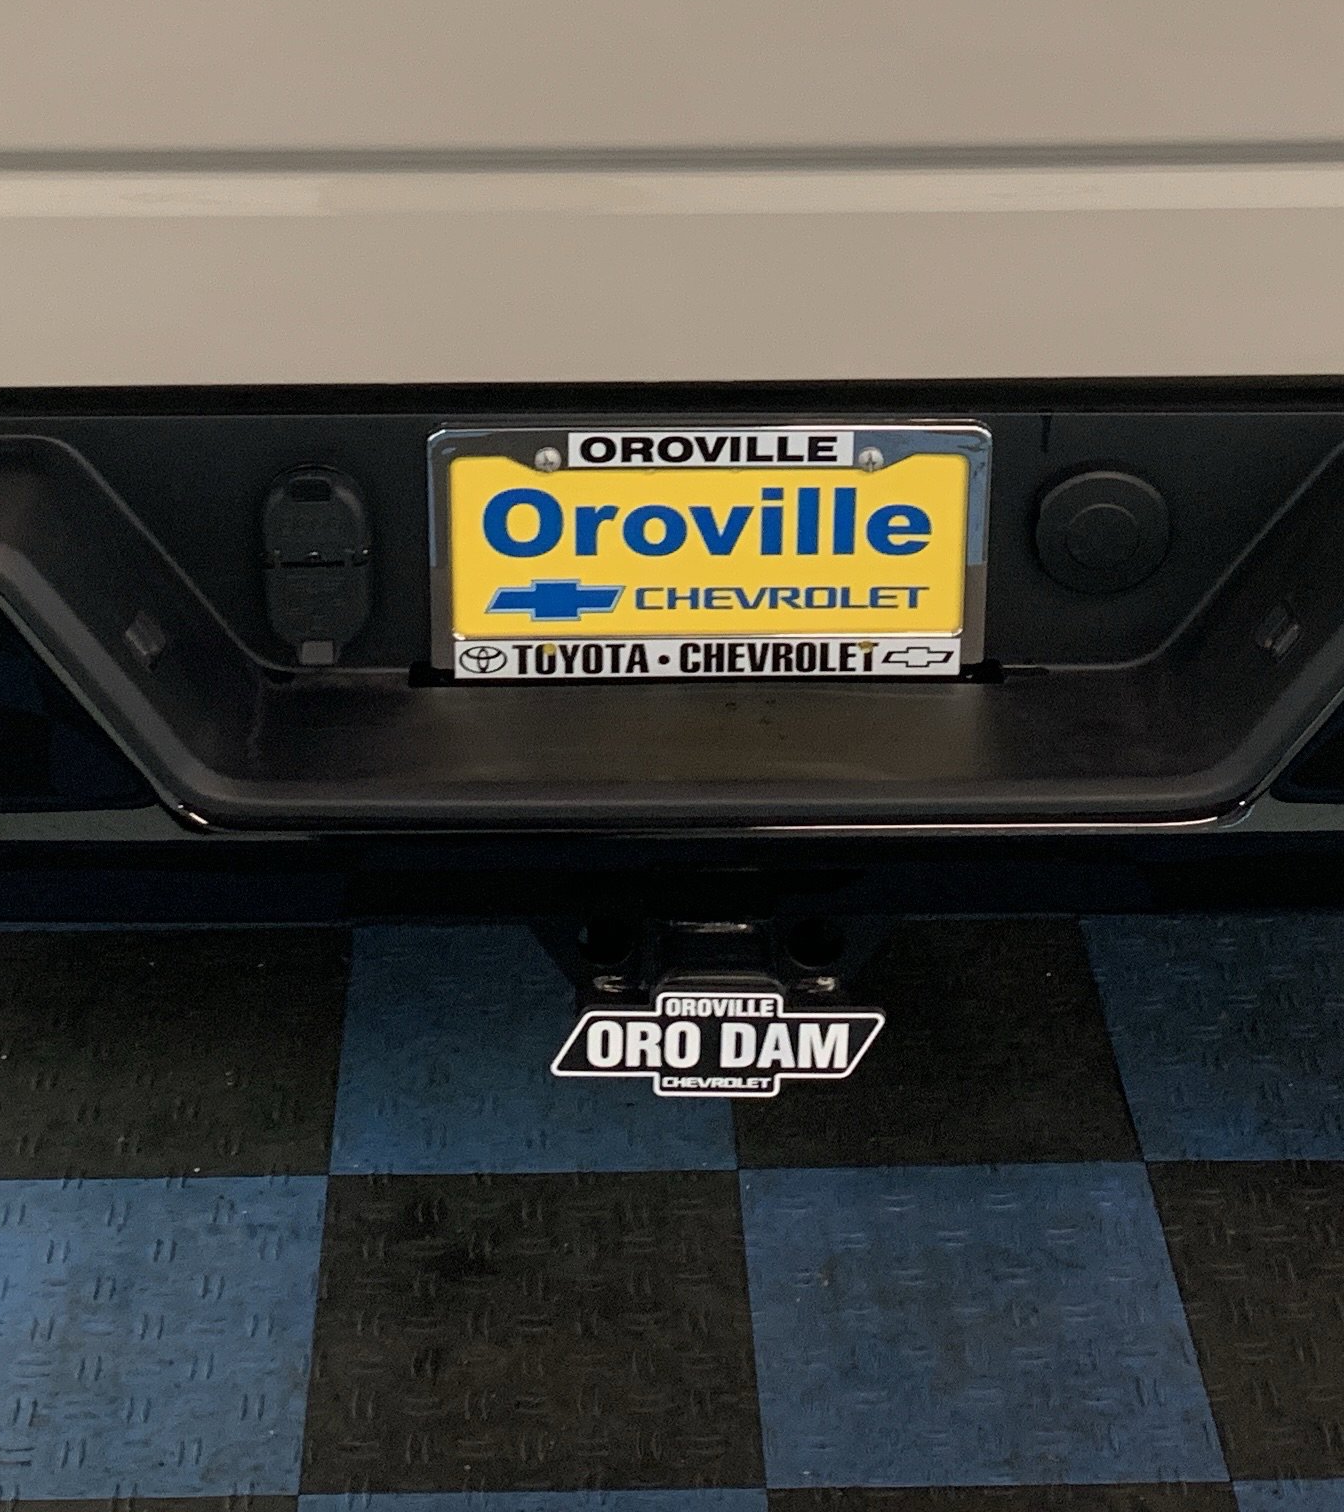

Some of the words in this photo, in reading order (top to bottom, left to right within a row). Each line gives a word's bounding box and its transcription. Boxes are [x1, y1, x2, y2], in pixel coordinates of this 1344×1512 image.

[579, 435, 838, 464] OROVILLE
[482, 487, 933, 558] Oroville
[634, 586, 931, 611] CHEVROLET
[512, 642, 649, 675] TOYOTA
[679, 641, 880, 674] CHEVROLET
[665, 997, 775, 1017] OROVILLE
[586, 1019, 702, 1069] ORO
[719, 1021, 851, 1069] DAM
[661, 1075, 772, 1089] CHEVROLET
